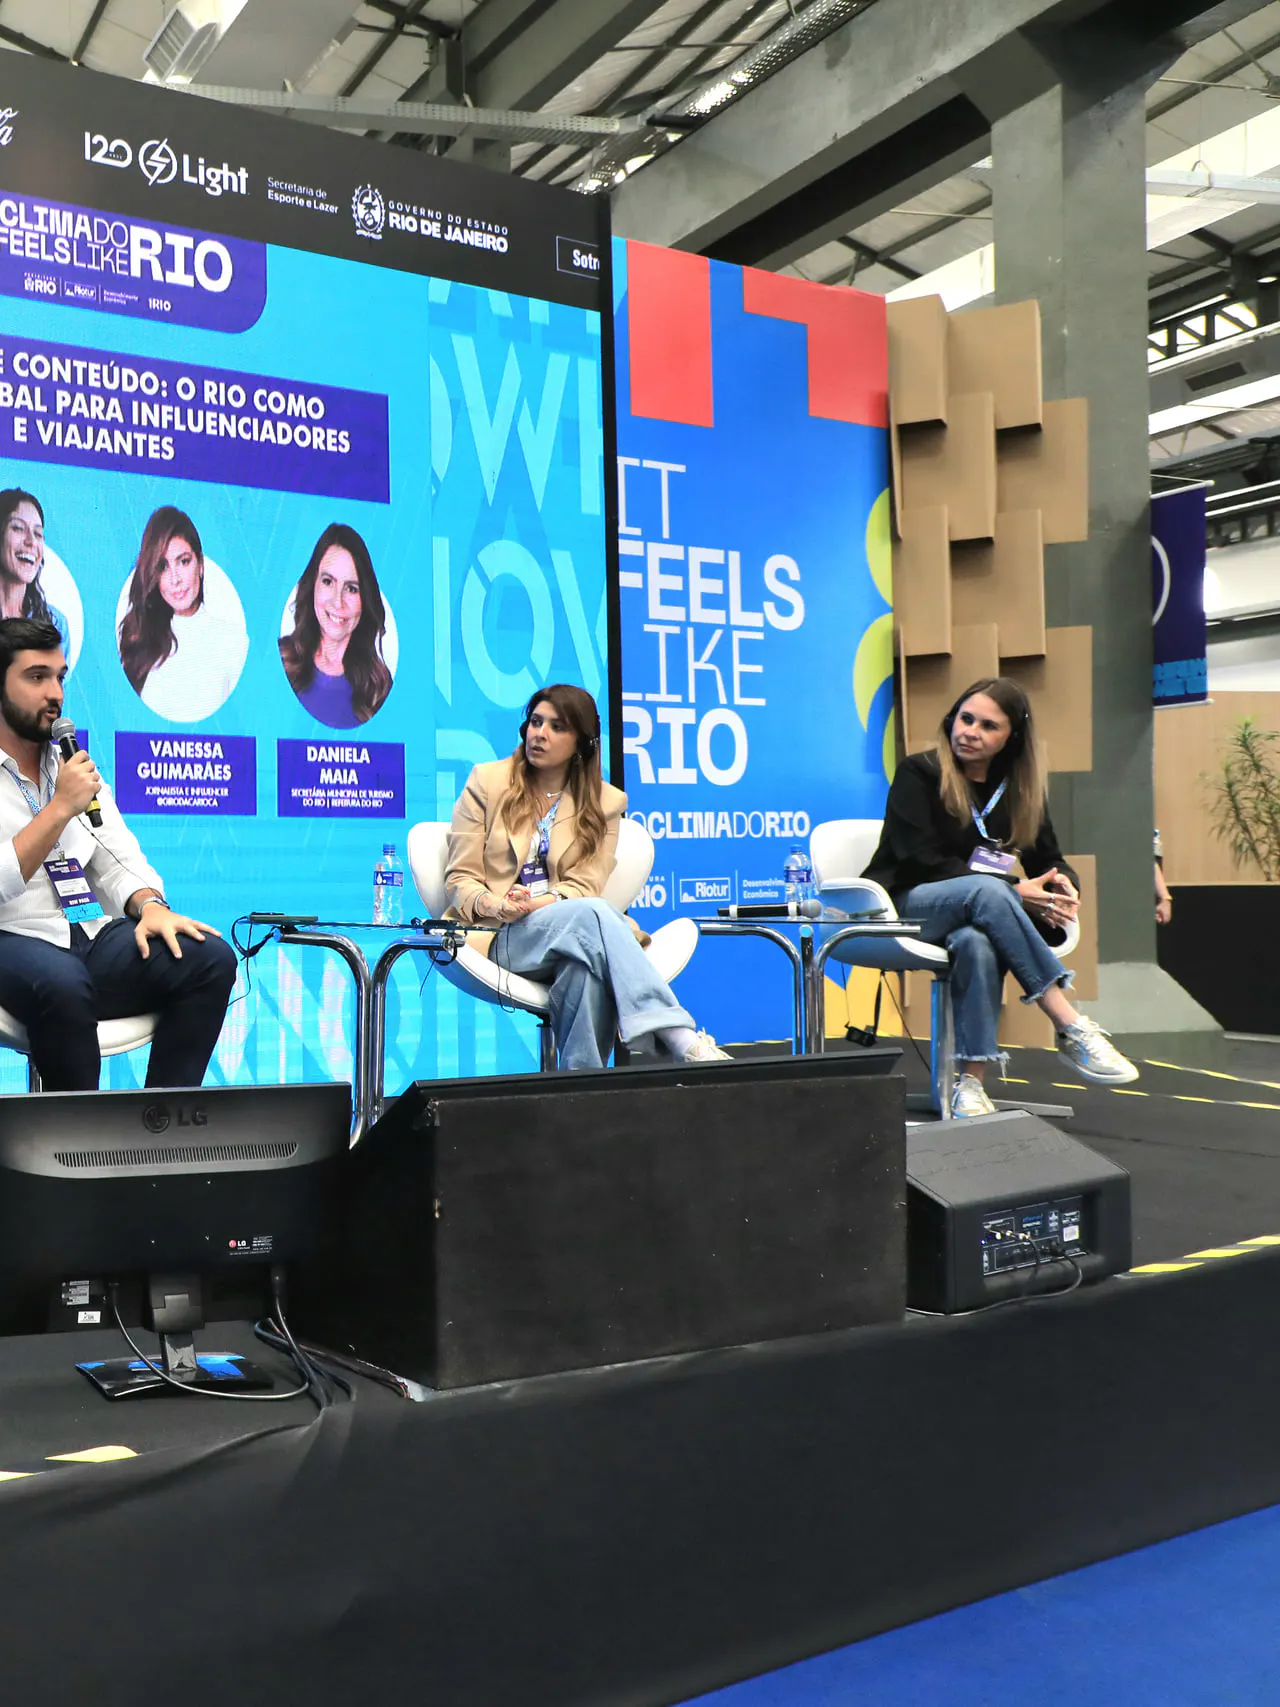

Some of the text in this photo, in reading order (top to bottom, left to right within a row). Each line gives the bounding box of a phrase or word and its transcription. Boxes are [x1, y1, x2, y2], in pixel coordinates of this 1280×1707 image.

[183, 154, 248, 195] Light
[268, 177, 326, 200] Secretaria de
[268, 187, 305, 206] Esporte
[314, 200, 338, 213] Lazer
[389, 201, 507, 234] GOVERNO DO ESTADO
[389, 212, 508, 252] RIO DE JANEIRO
[130, 225, 232, 292] RIO
[572, 249, 600, 270] Sotr
[35, 279, 57, 295] RIO
[13, 352, 167, 397] CONTEÚDO:
[177, 377, 195, 400] O
[204, 380, 245, 408] RIO
[254, 389, 324, 419] COMO
[57, 390, 123, 423] PARA
[131, 401, 351, 454] INFLUENCIADORES
[14, 417, 174, 460] E VIAJANTES
[150, 741, 223, 758] VANESSA
[307, 746, 370, 763] DANIELA
[137, 762, 231, 780] GUIMARÃES
[320, 769, 358, 784] MAIA
[695, 880, 729, 897] Riotur
[177, 1105, 208, 1127] LG
